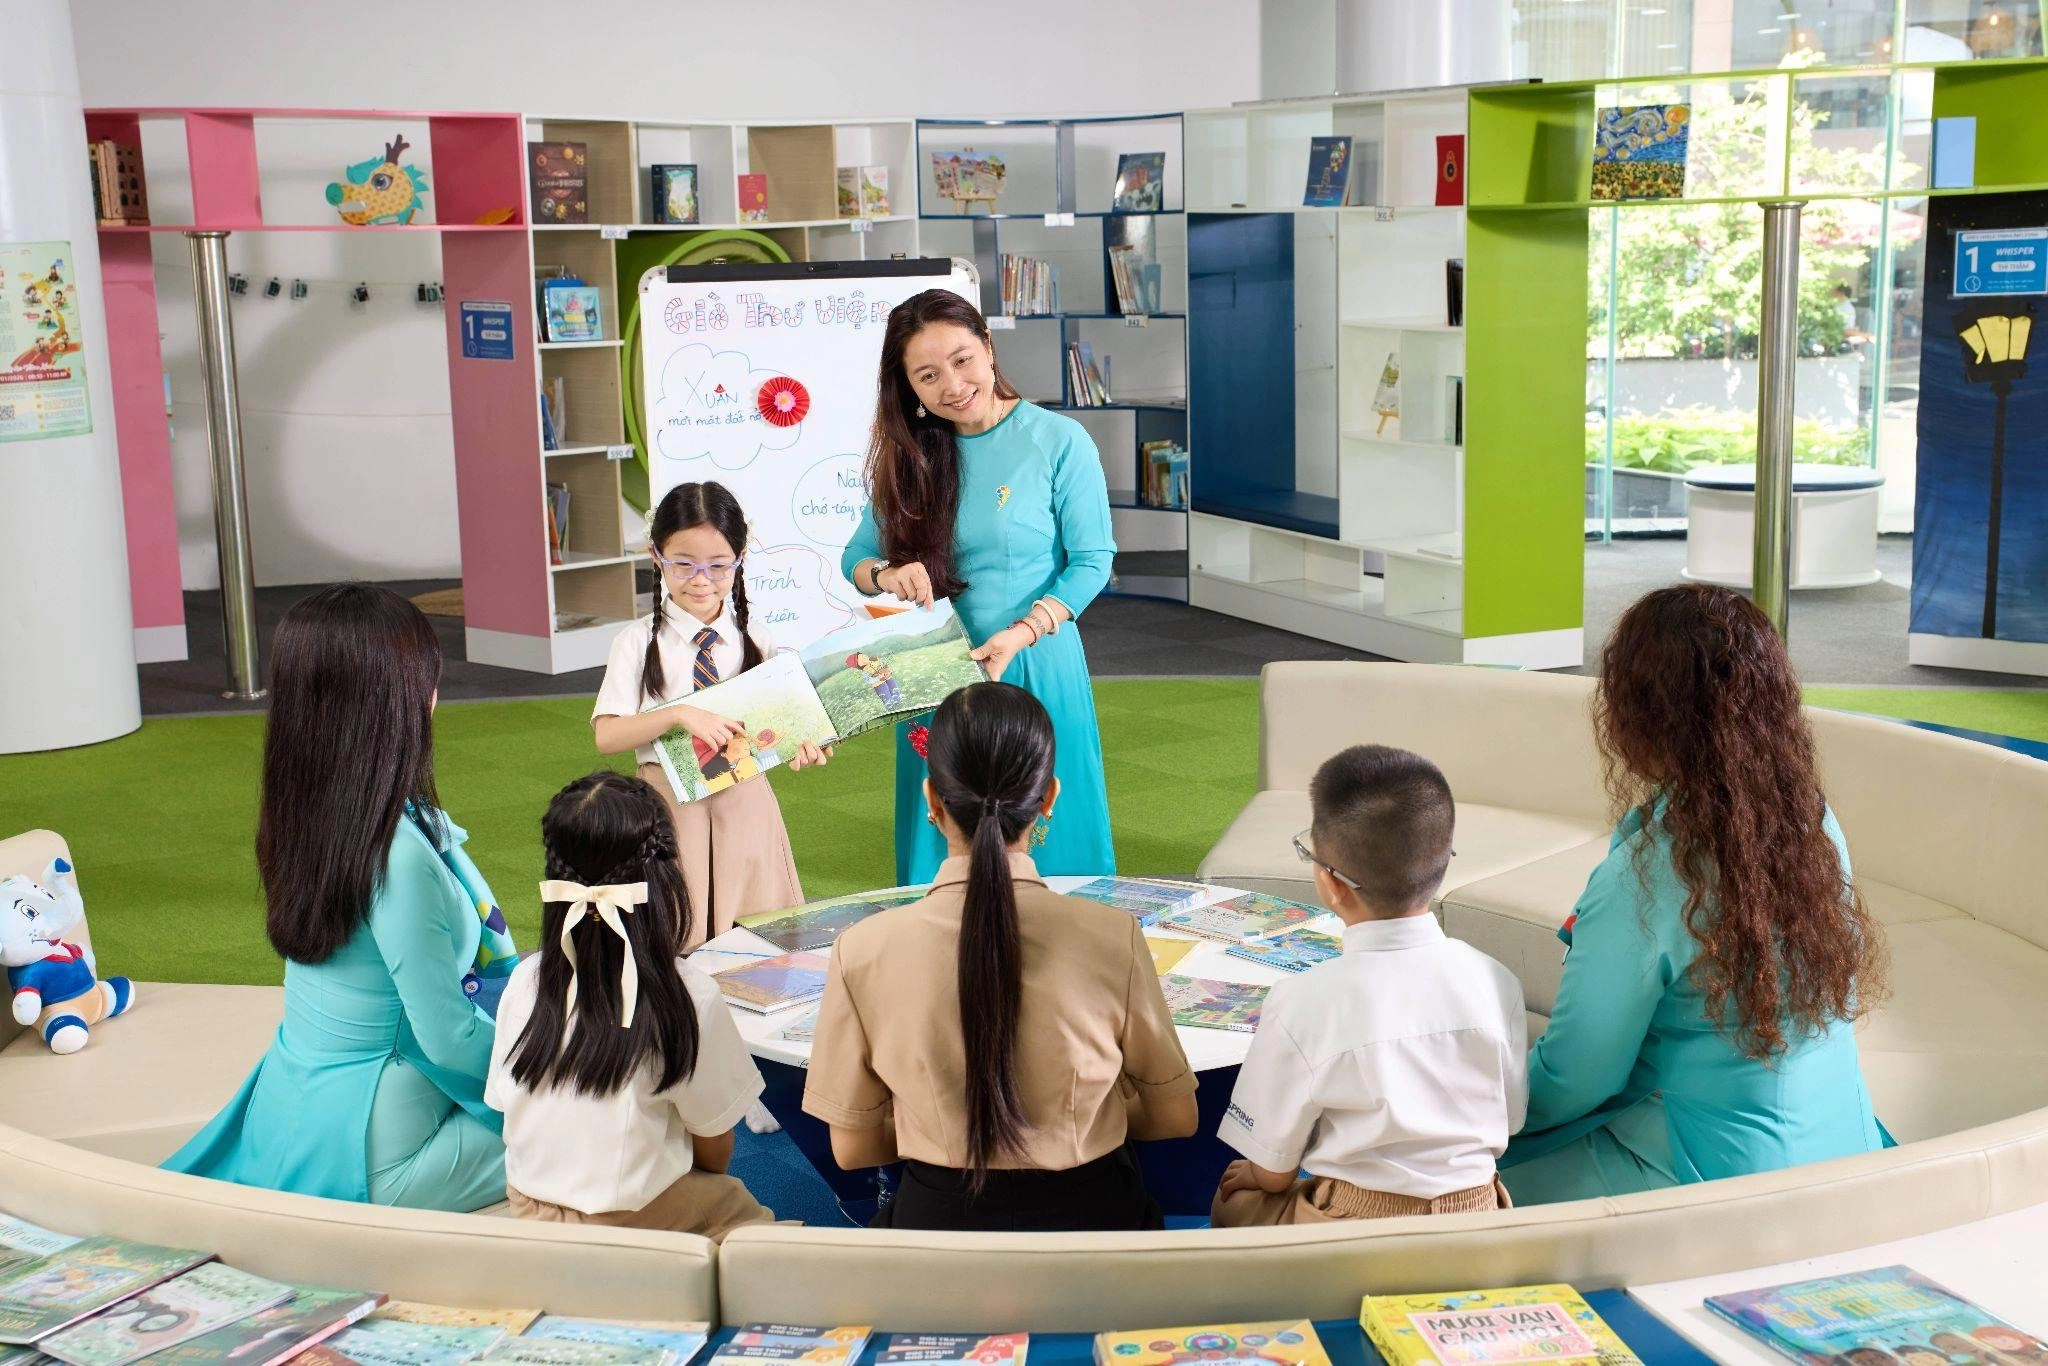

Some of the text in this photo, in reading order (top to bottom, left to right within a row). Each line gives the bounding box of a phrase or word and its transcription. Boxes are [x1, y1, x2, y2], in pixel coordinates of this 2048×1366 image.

[1965, 246, 1979, 273] 1
[1996, 246, 2035, 256] WHISPER
[465, 314, 475, 340] 1
